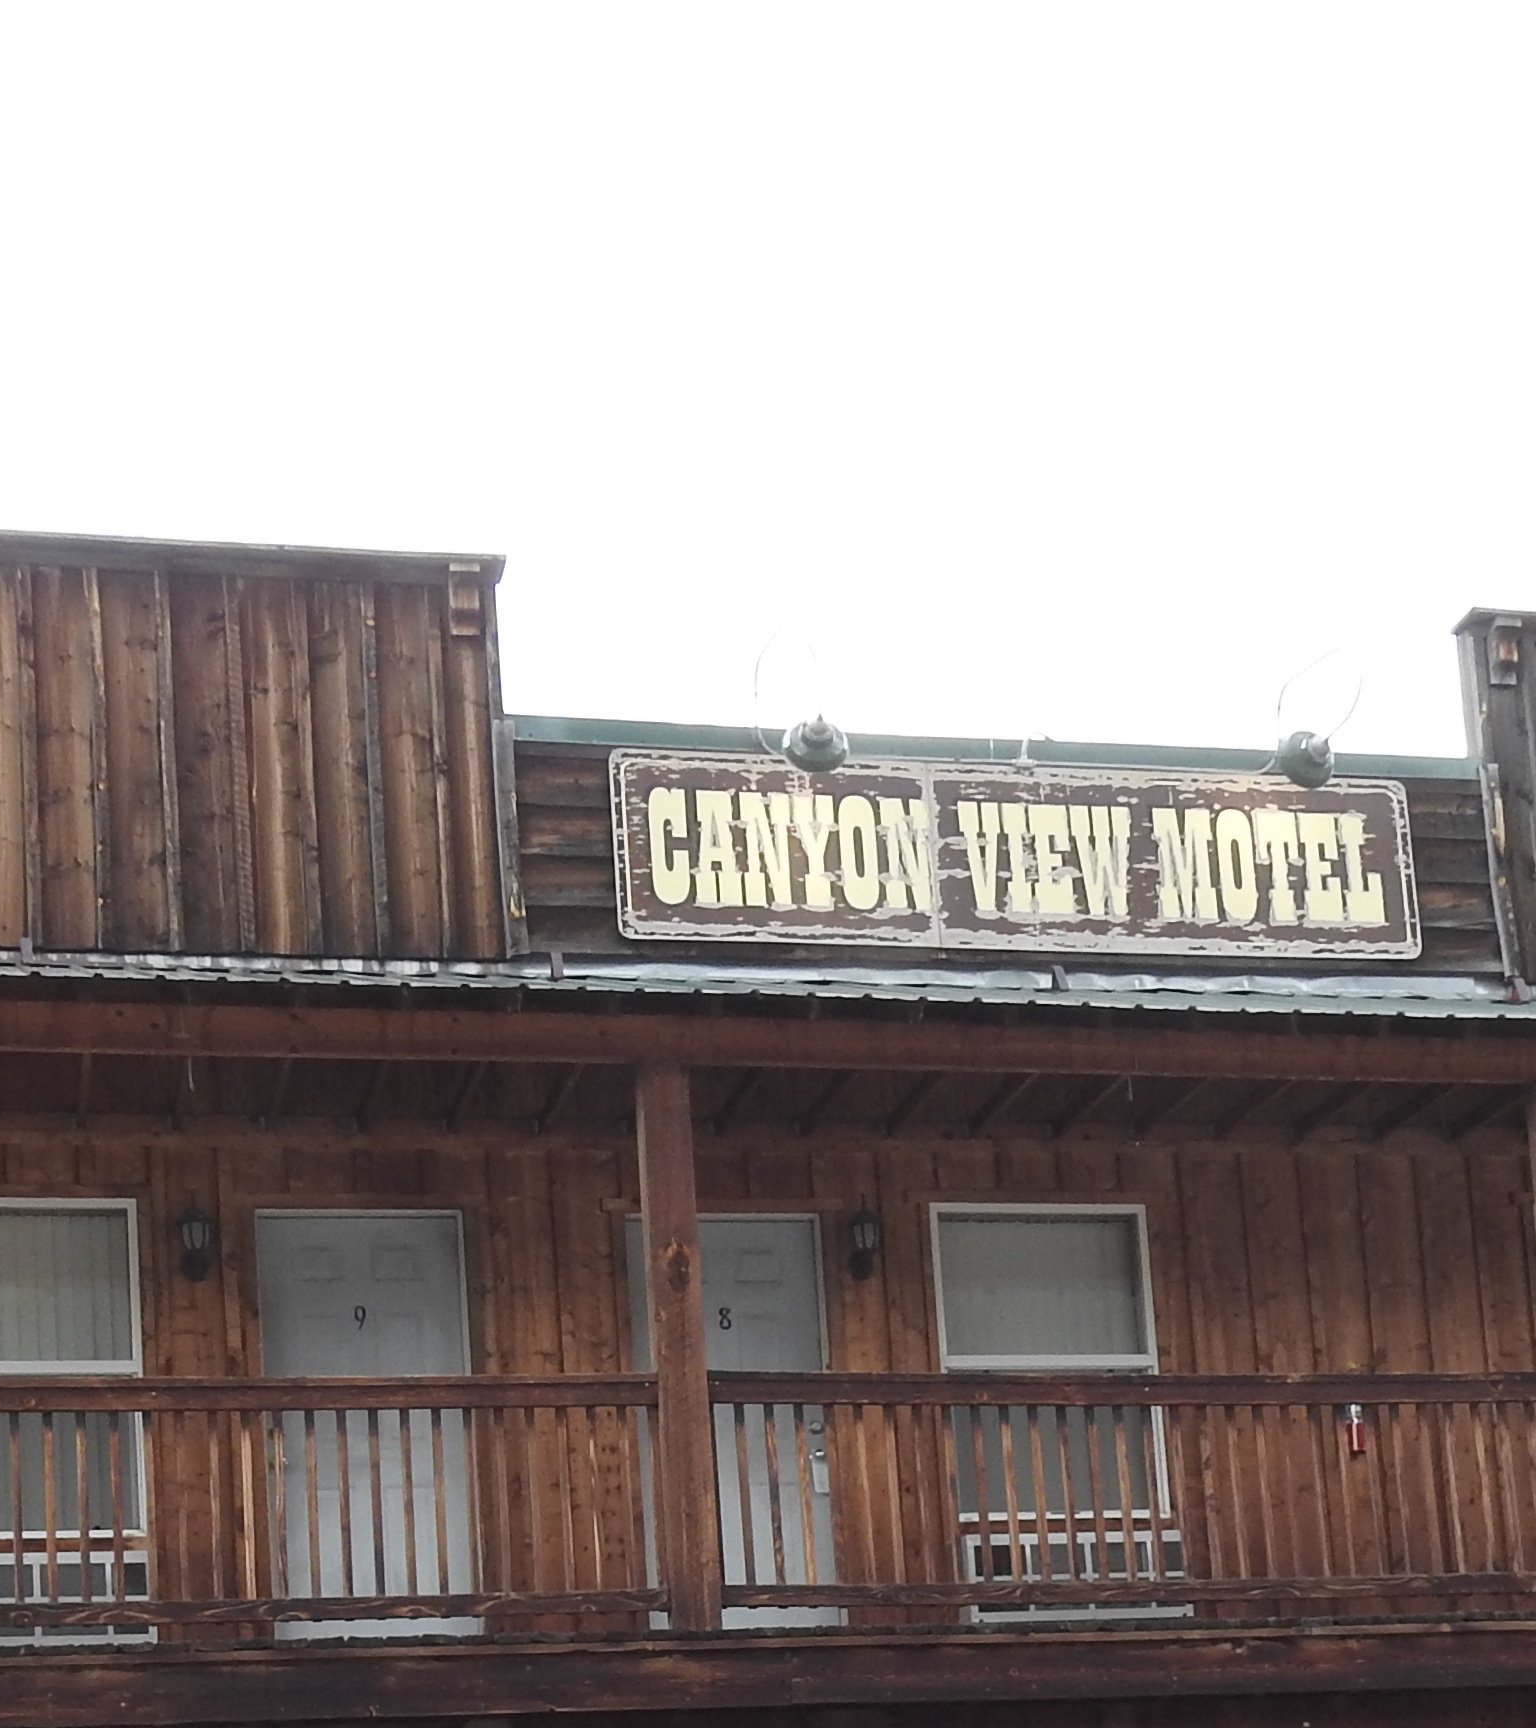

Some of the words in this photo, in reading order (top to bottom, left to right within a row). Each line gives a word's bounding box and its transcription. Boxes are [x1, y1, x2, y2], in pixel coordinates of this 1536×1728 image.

[646, 785, 934, 913] CANYON
[957, 799, 1131, 921] VIEW
[1151, 806, 1387, 926] MOTEL
[354, 1305, 366, 1331] 9
[718, 1306, 732, 1330] 8
